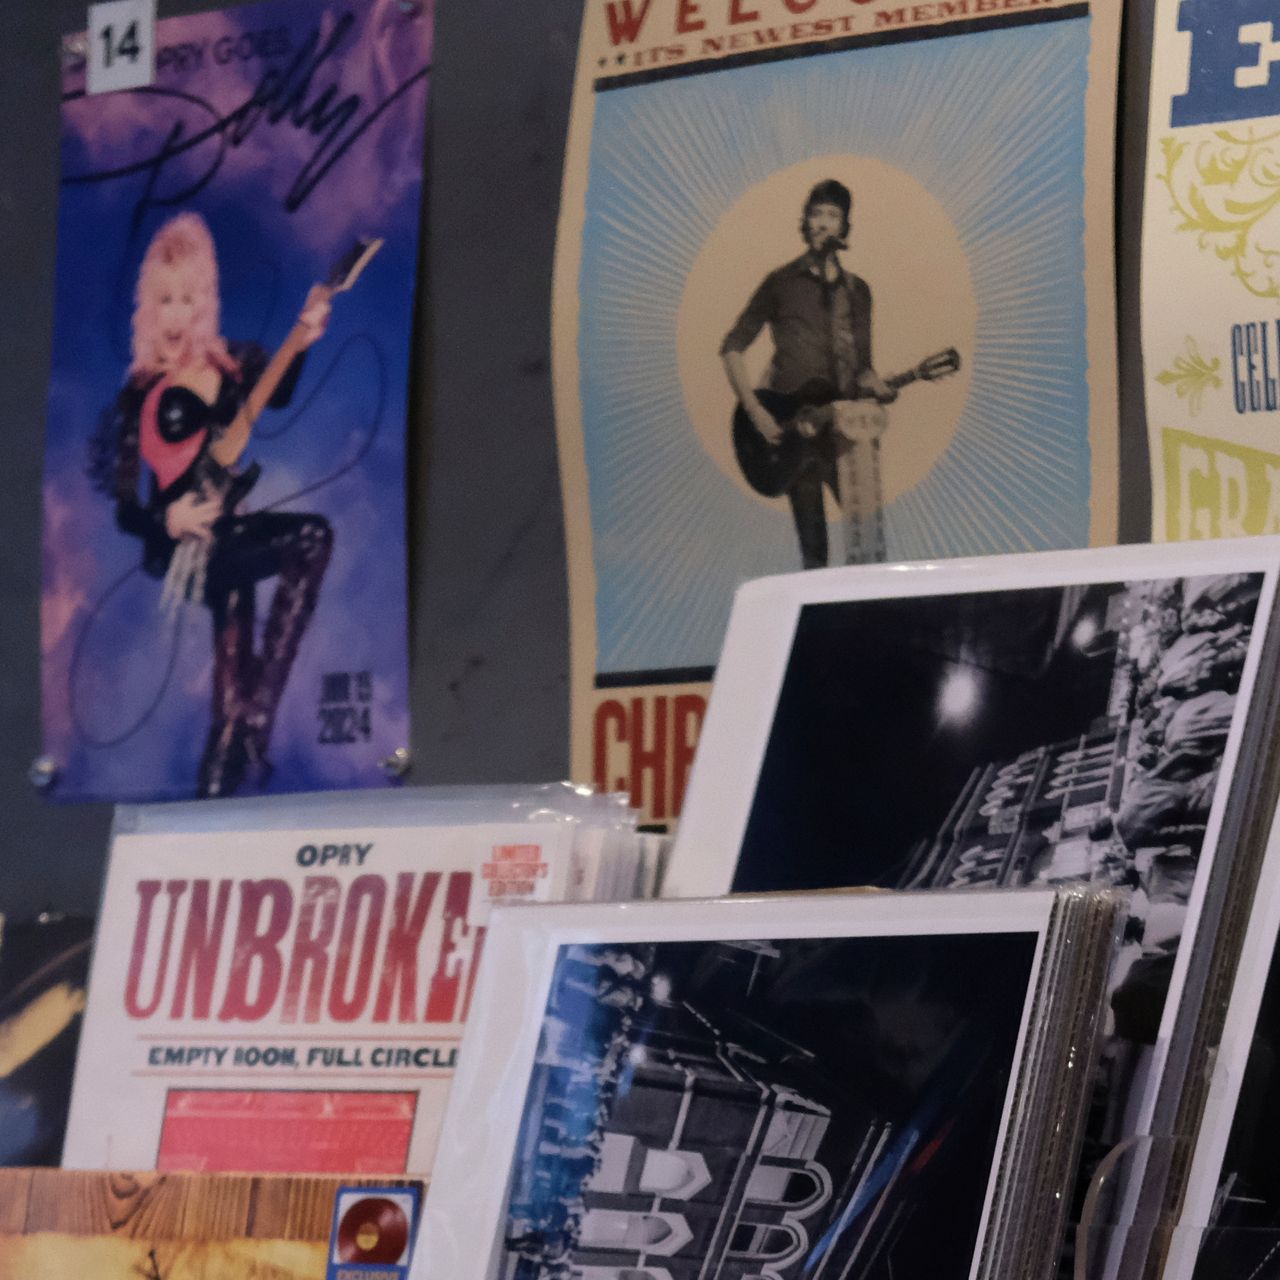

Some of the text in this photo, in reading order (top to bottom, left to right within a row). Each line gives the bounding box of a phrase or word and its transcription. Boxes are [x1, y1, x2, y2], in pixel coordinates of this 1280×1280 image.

[101, 22, 142, 67] 14
[605, 0, 870, 45] WEL
[701, 15, 853, 54] NEWEST
[875, 0, 1052, 26] MEMBE
[296, 843, 375, 868] OPRY
[124, 870, 486, 1024] UNBROKE
[149, 1047, 227, 1068] EMPTY
[307, 1046, 366, 1068] FULL
